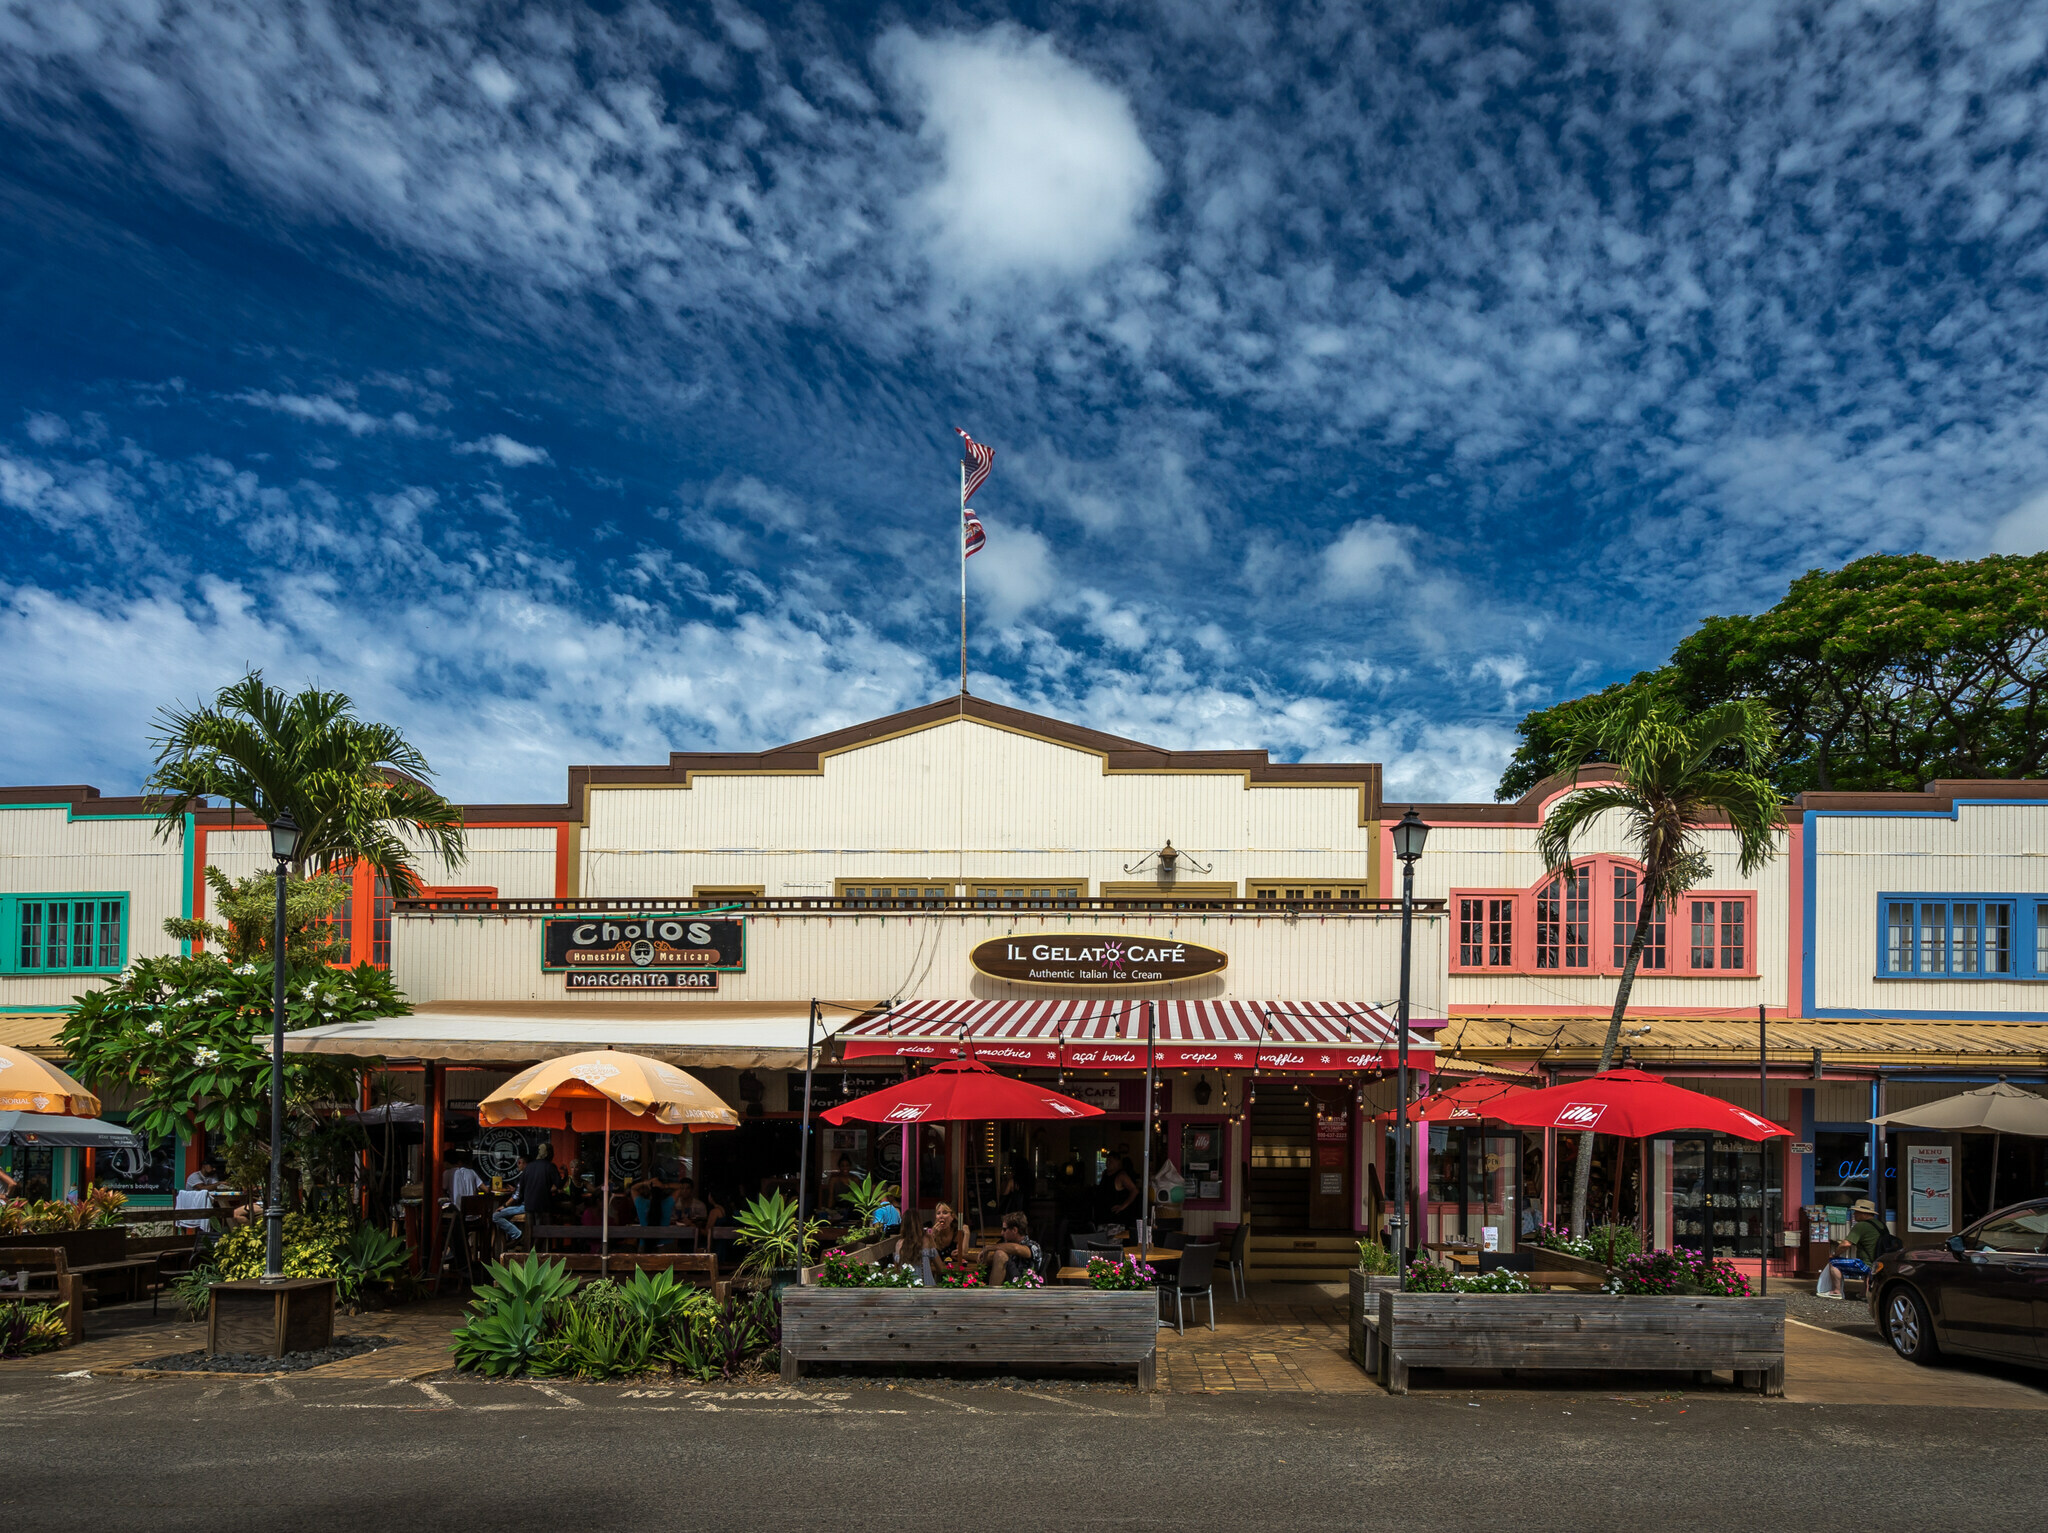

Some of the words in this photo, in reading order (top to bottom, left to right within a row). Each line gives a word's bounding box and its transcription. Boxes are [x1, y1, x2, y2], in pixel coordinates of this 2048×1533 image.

[574, 952, 626, 962] Homestyle
[659, 952, 710, 961] Mexican
[1127, 944, 1185, 963] CAFÉ
[1029, 968, 1075, 979] Authentic
[1079, 969, 1108, 979] Italian
[1113, 970, 1126, 979] Ice
[1131, 969, 1162, 980] Cream
[573, 973, 668, 986] MARGARITA
[677, 973, 710, 987] BAR
[896, 1045, 935, 1055] gelato
[975, 1048, 1032, 1059] smoothies
[1102, 1051, 1135, 1062] bowls
[1180, 1052, 1217, 1062] crepes
[1259, 1054, 1305, 1066] waffles
[1347, 1055, 1383, 1066] coffee
[1085, 1086, 1116, 1097] CAFÉ
[891, 1107, 923, 1121] illy
[1561, 1106, 1598, 1123] illy
[1195, 1135, 1210, 1149] illy
[135, 1183, 160, 1191] boutique
[680, 1390, 854, 1401] PARKING
